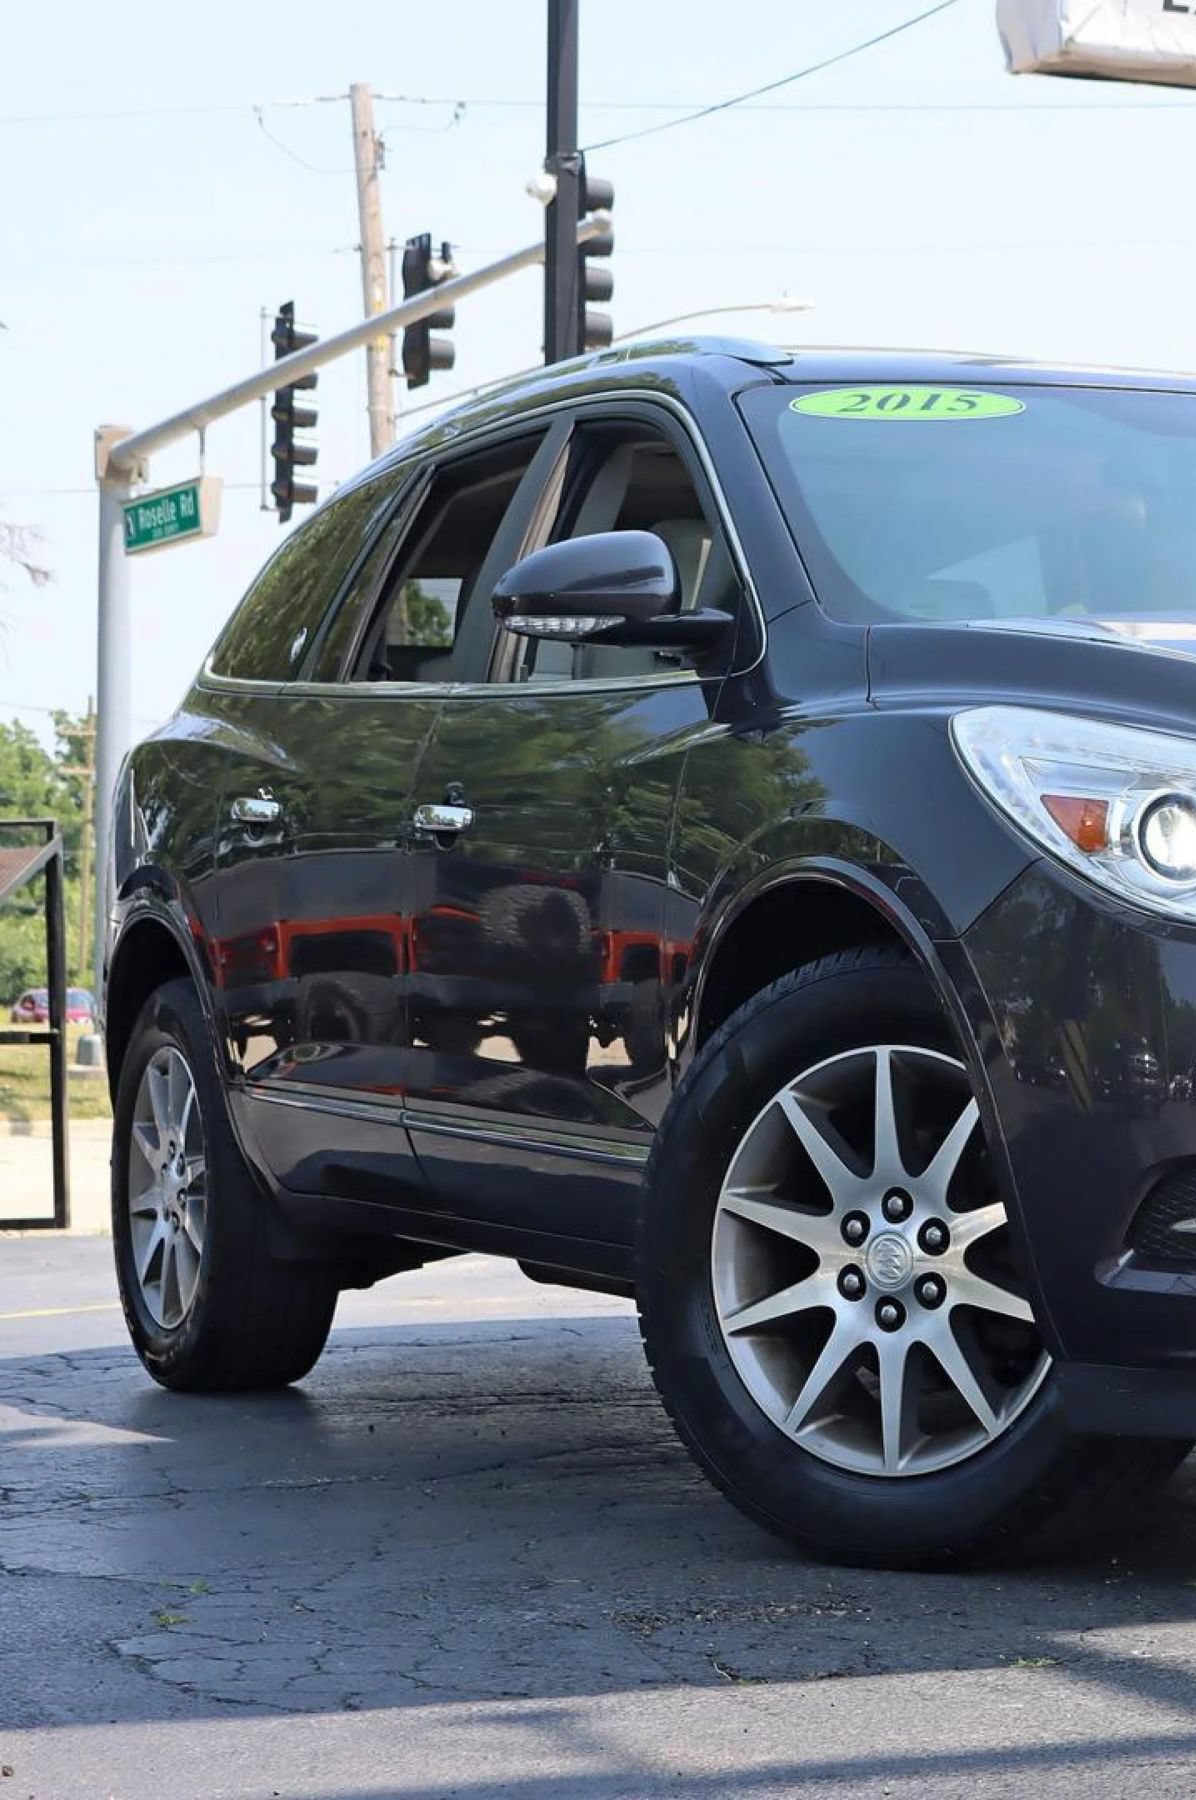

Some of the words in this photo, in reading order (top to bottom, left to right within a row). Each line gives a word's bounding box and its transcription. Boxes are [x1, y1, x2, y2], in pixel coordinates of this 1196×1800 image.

[837, 393, 981, 412] 2015
[138, 498, 178, 531] Roselle
[180, 488, 195, 517] Rd
